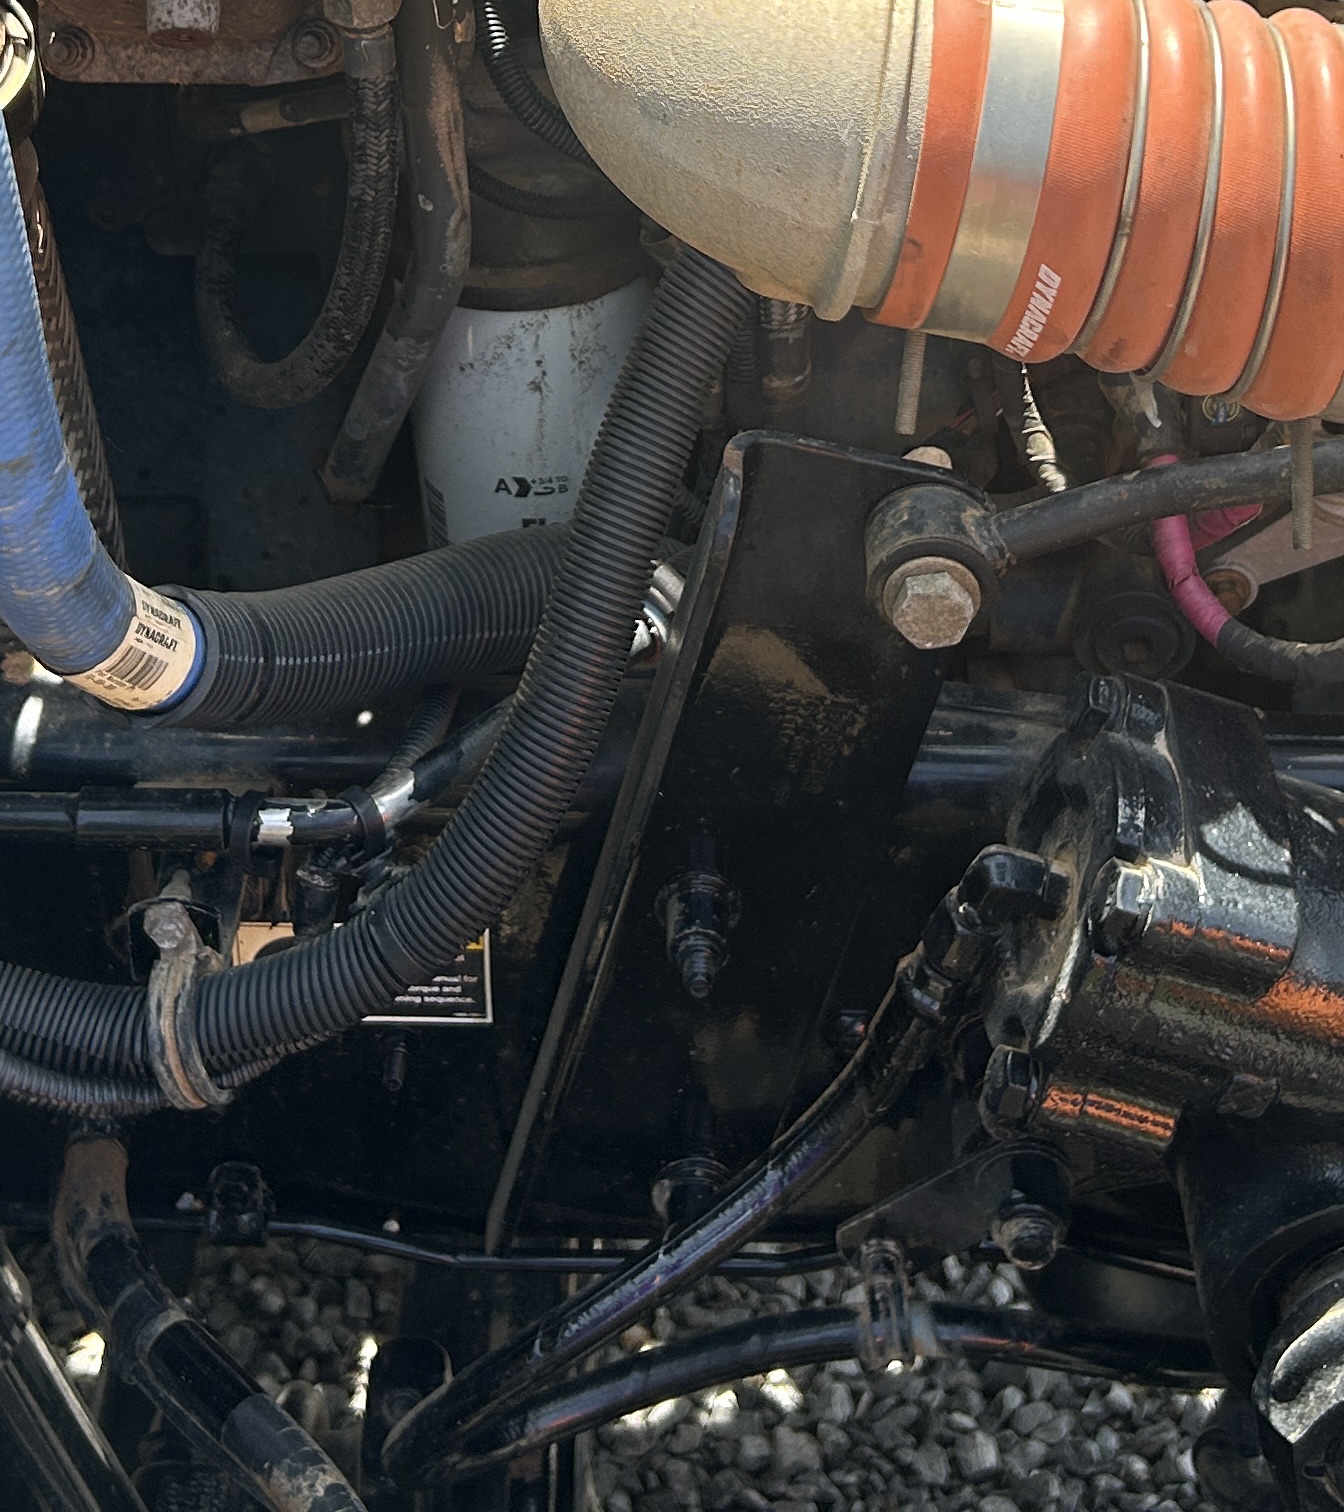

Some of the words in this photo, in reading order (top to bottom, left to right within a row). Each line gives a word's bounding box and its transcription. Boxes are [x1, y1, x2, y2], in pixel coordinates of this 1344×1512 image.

[494, 478, 513, 495] A
[558, 484, 568, 494] B
[135, 622, 179, 652] DYNACRAFT
